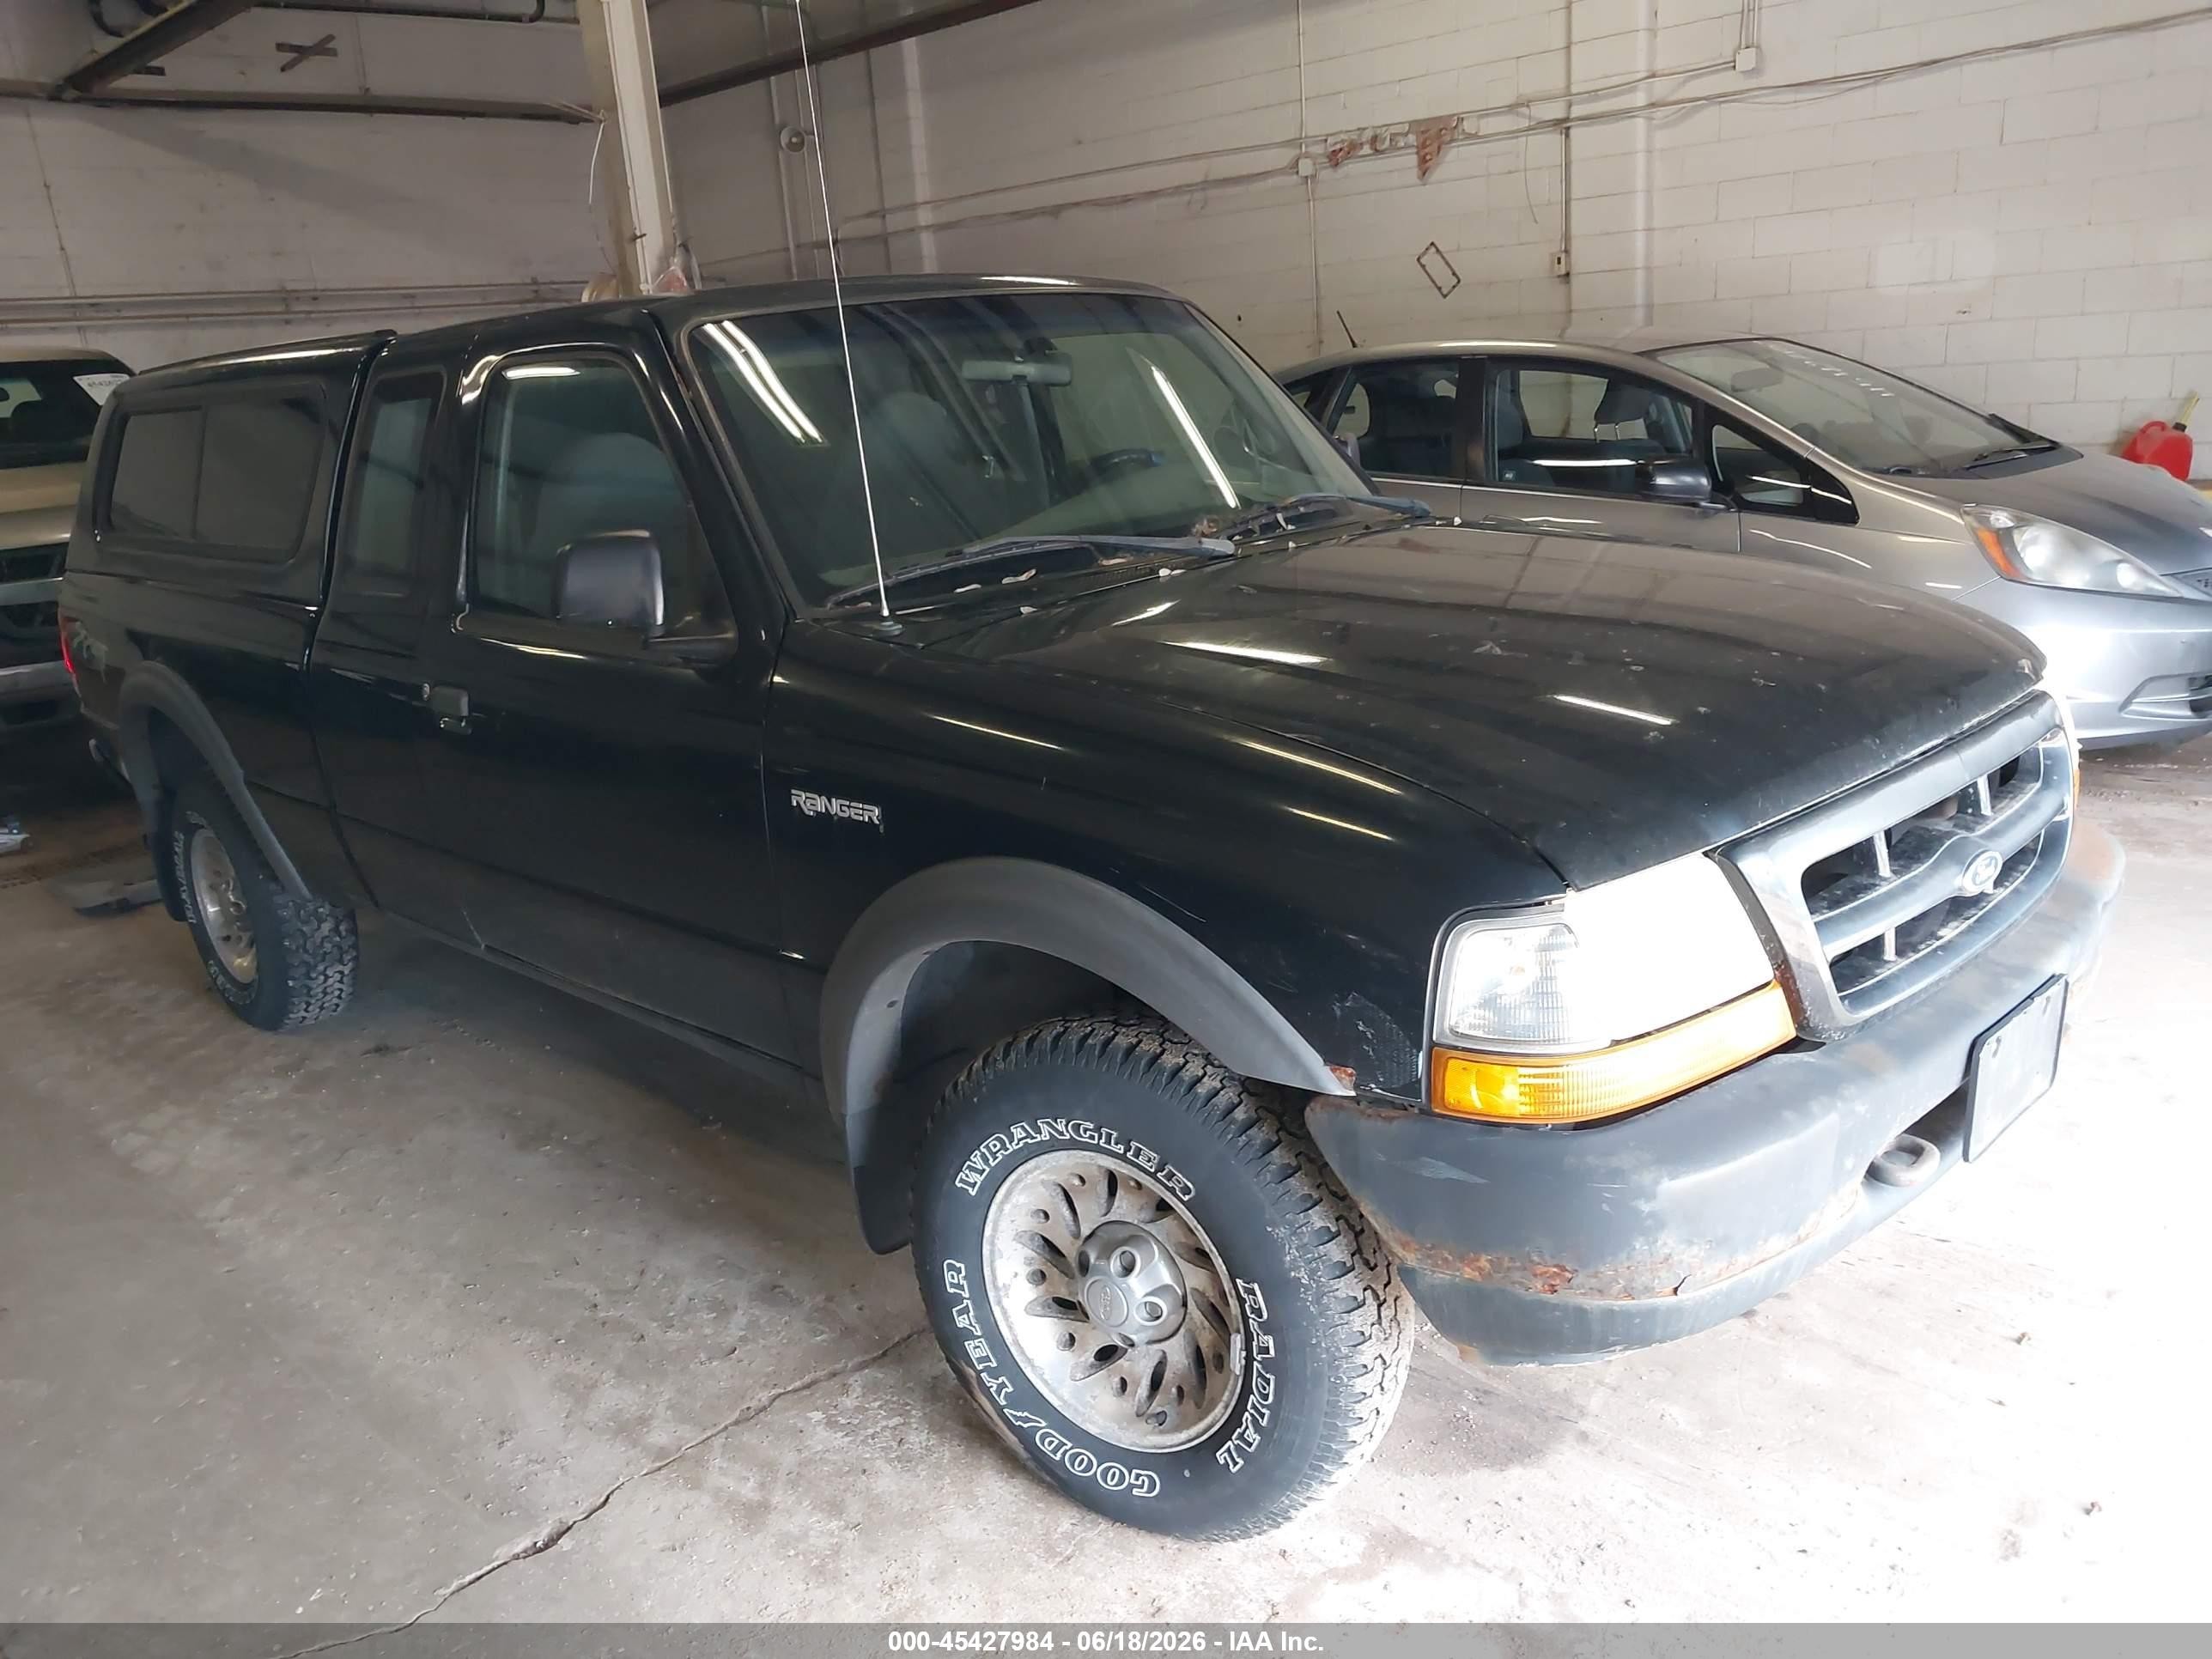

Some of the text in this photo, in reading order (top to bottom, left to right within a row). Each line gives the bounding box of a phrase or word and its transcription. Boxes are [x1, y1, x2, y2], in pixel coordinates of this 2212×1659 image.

[791, 788, 880, 825] RANGER
[954, 1118, 1196, 1200] WRANGLER
[1216, 1278, 1276, 1474] RADIAL
